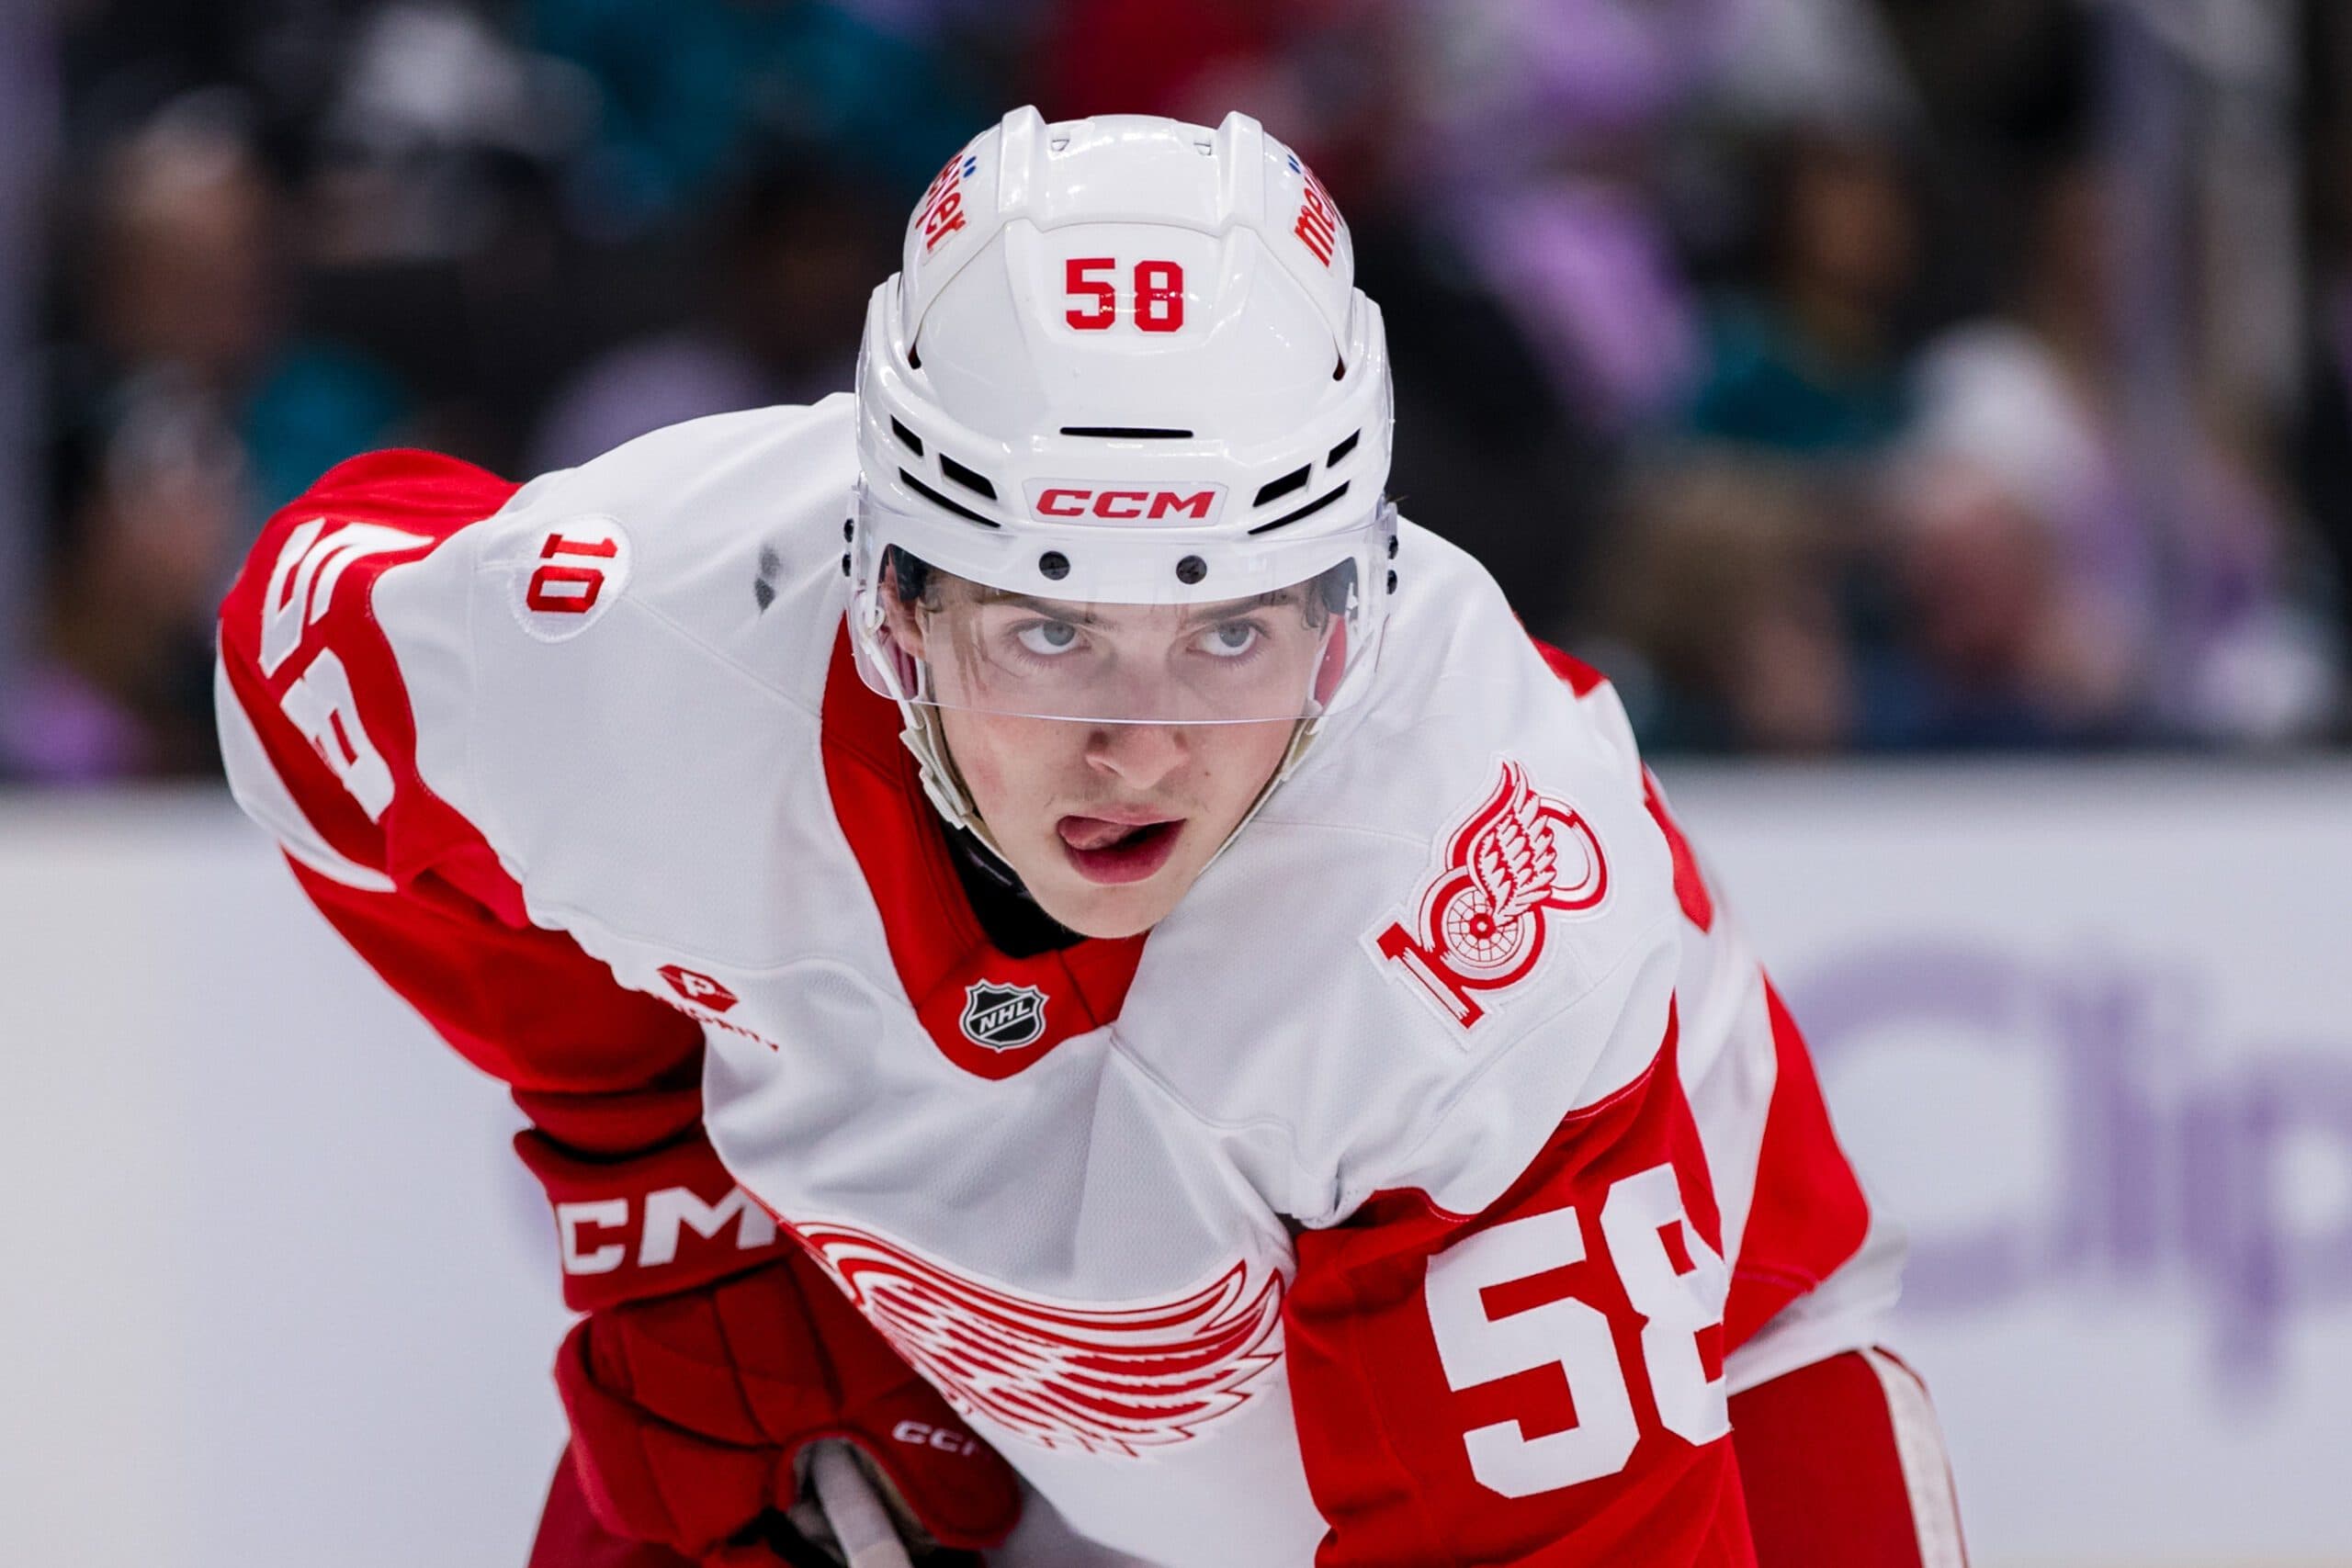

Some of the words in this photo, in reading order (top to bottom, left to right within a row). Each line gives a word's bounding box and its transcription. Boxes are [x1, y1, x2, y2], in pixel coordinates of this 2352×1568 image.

[1065, 257, 1184, 333] 58
[1035, 489, 1216, 519] CCM
[526, 532, 618, 615] 10
[979, 999, 1031, 1033] NHL
[557, 1185, 778, 1276] CM
[1424, 1162, 1733, 1499] 58
